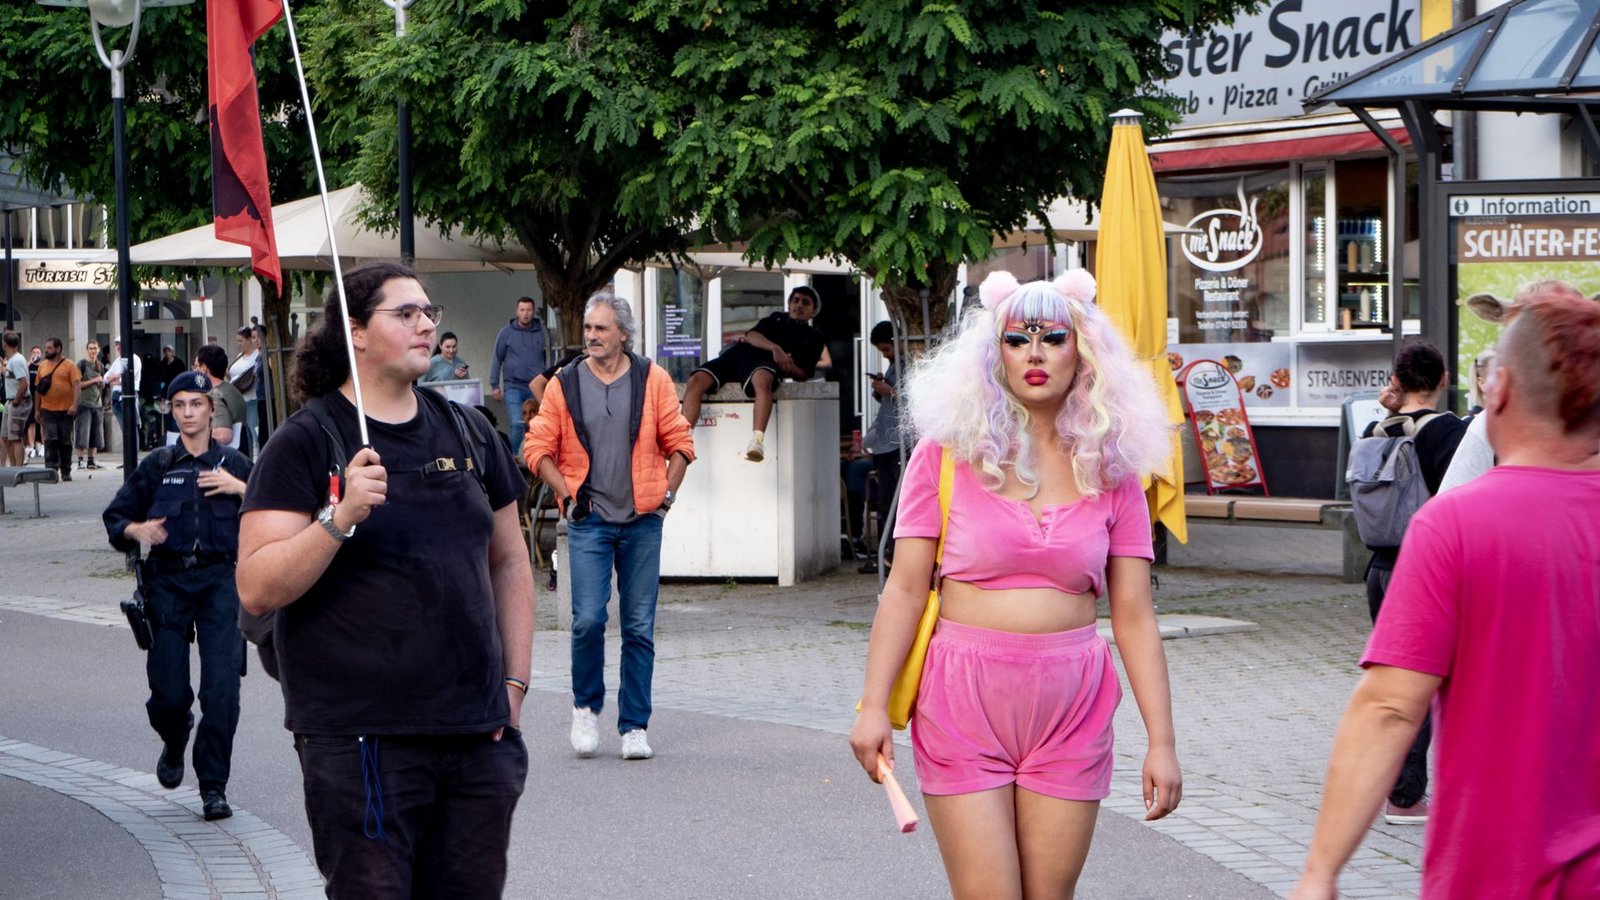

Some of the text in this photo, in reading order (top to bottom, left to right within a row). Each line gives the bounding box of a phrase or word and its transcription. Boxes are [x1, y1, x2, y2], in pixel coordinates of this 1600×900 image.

[1154, 0, 1414, 81] ster Snack
[1223, 83, 1278, 115] Pizza
[1481, 196, 1591, 214] Information
[1464, 223, 1600, 258] SCHÄFER-FE
[93, 267, 114, 285] ST
